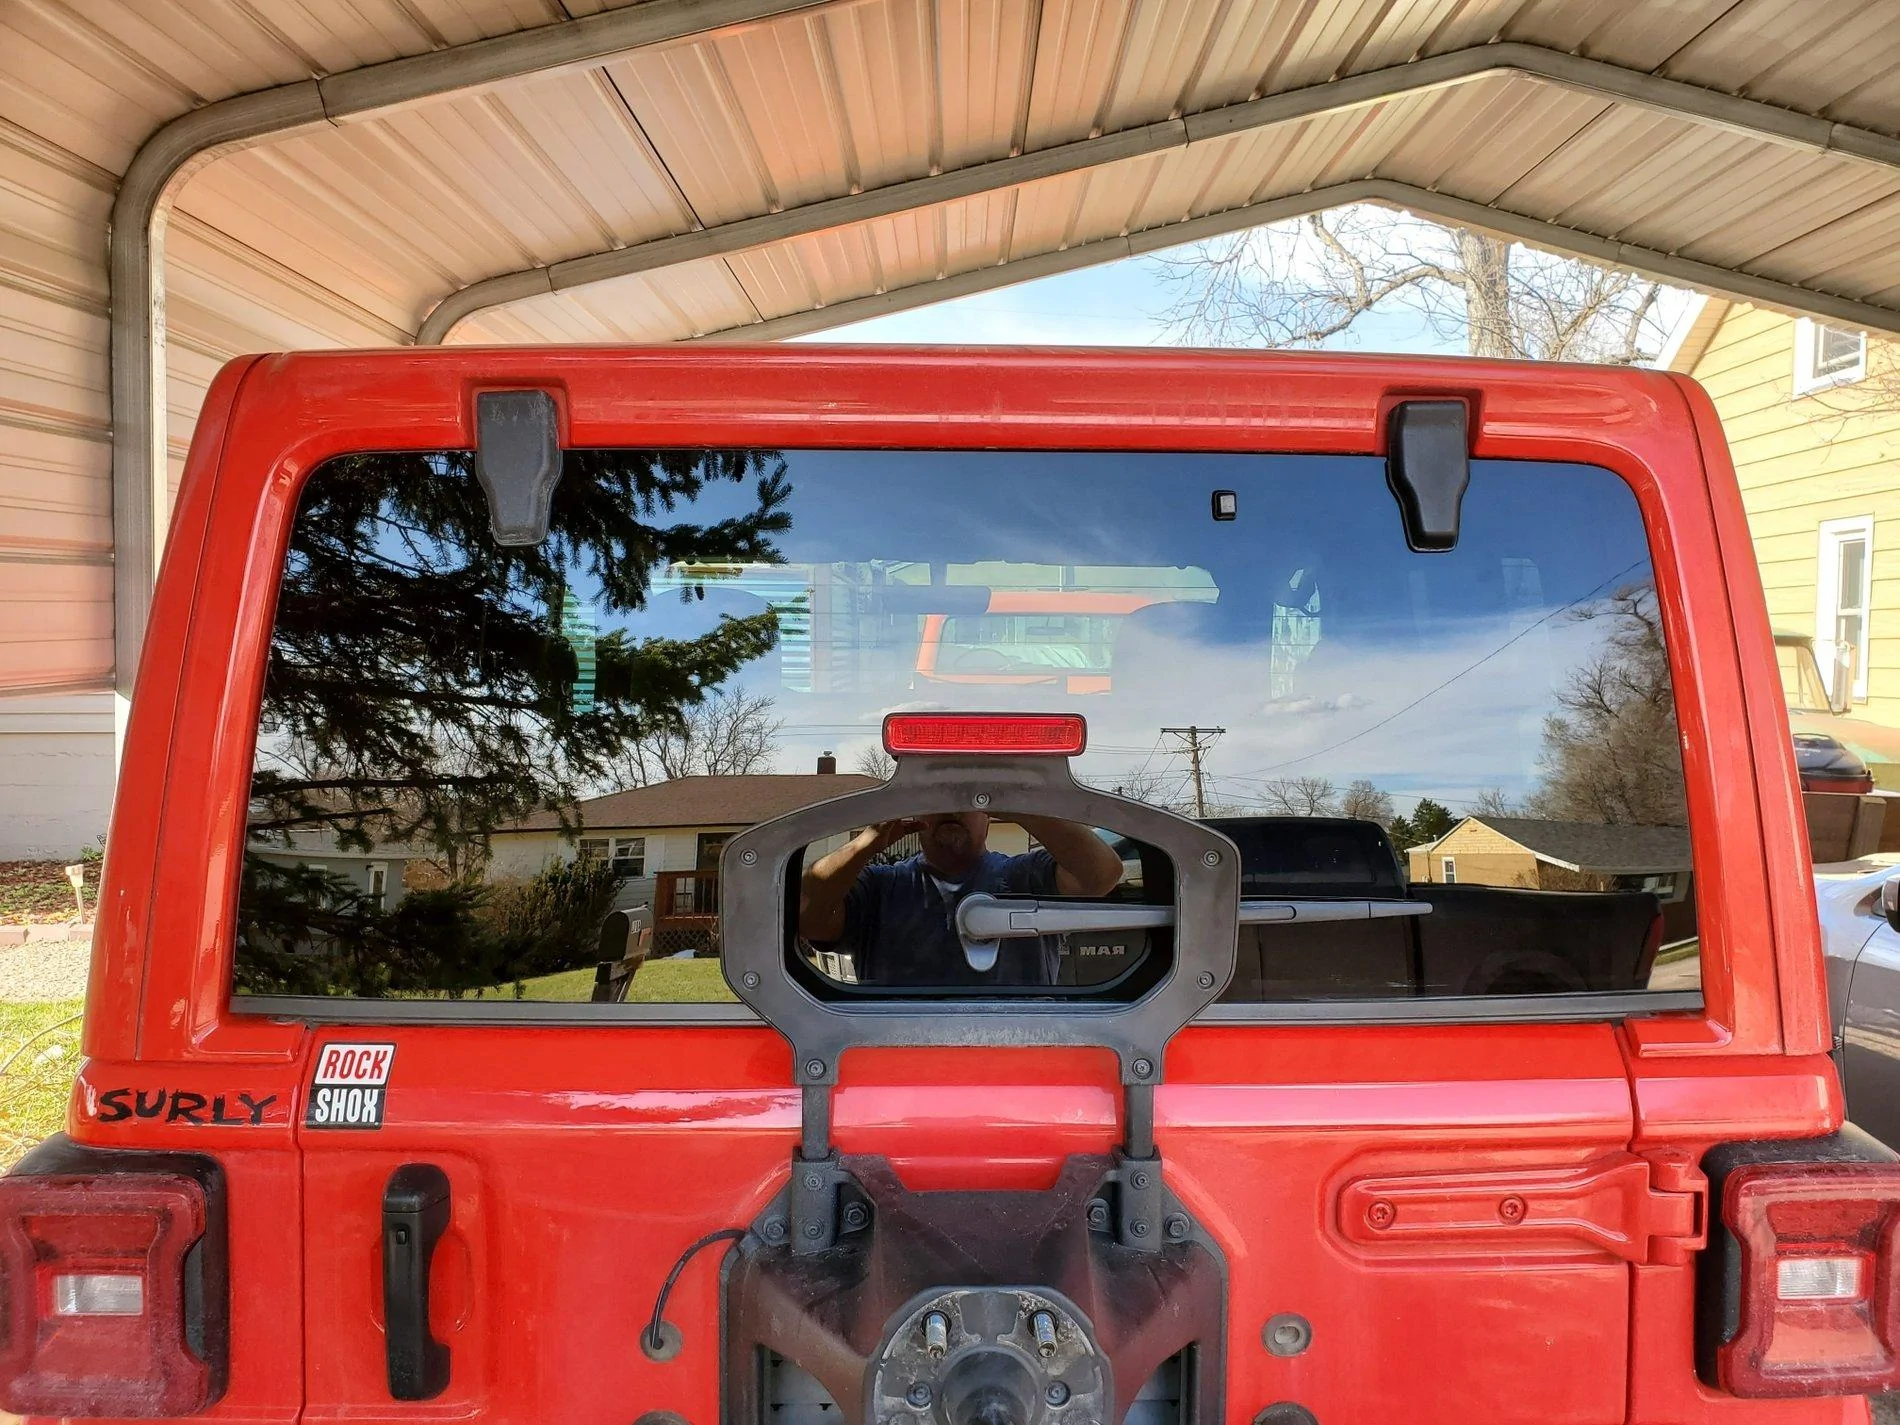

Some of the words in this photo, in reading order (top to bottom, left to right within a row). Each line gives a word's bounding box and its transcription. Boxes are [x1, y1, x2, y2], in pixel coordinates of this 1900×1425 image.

[322, 1049, 388, 1080] ROCK
[97, 1088, 277, 1126] SURLY
[315, 1087, 379, 1123] SHOX
